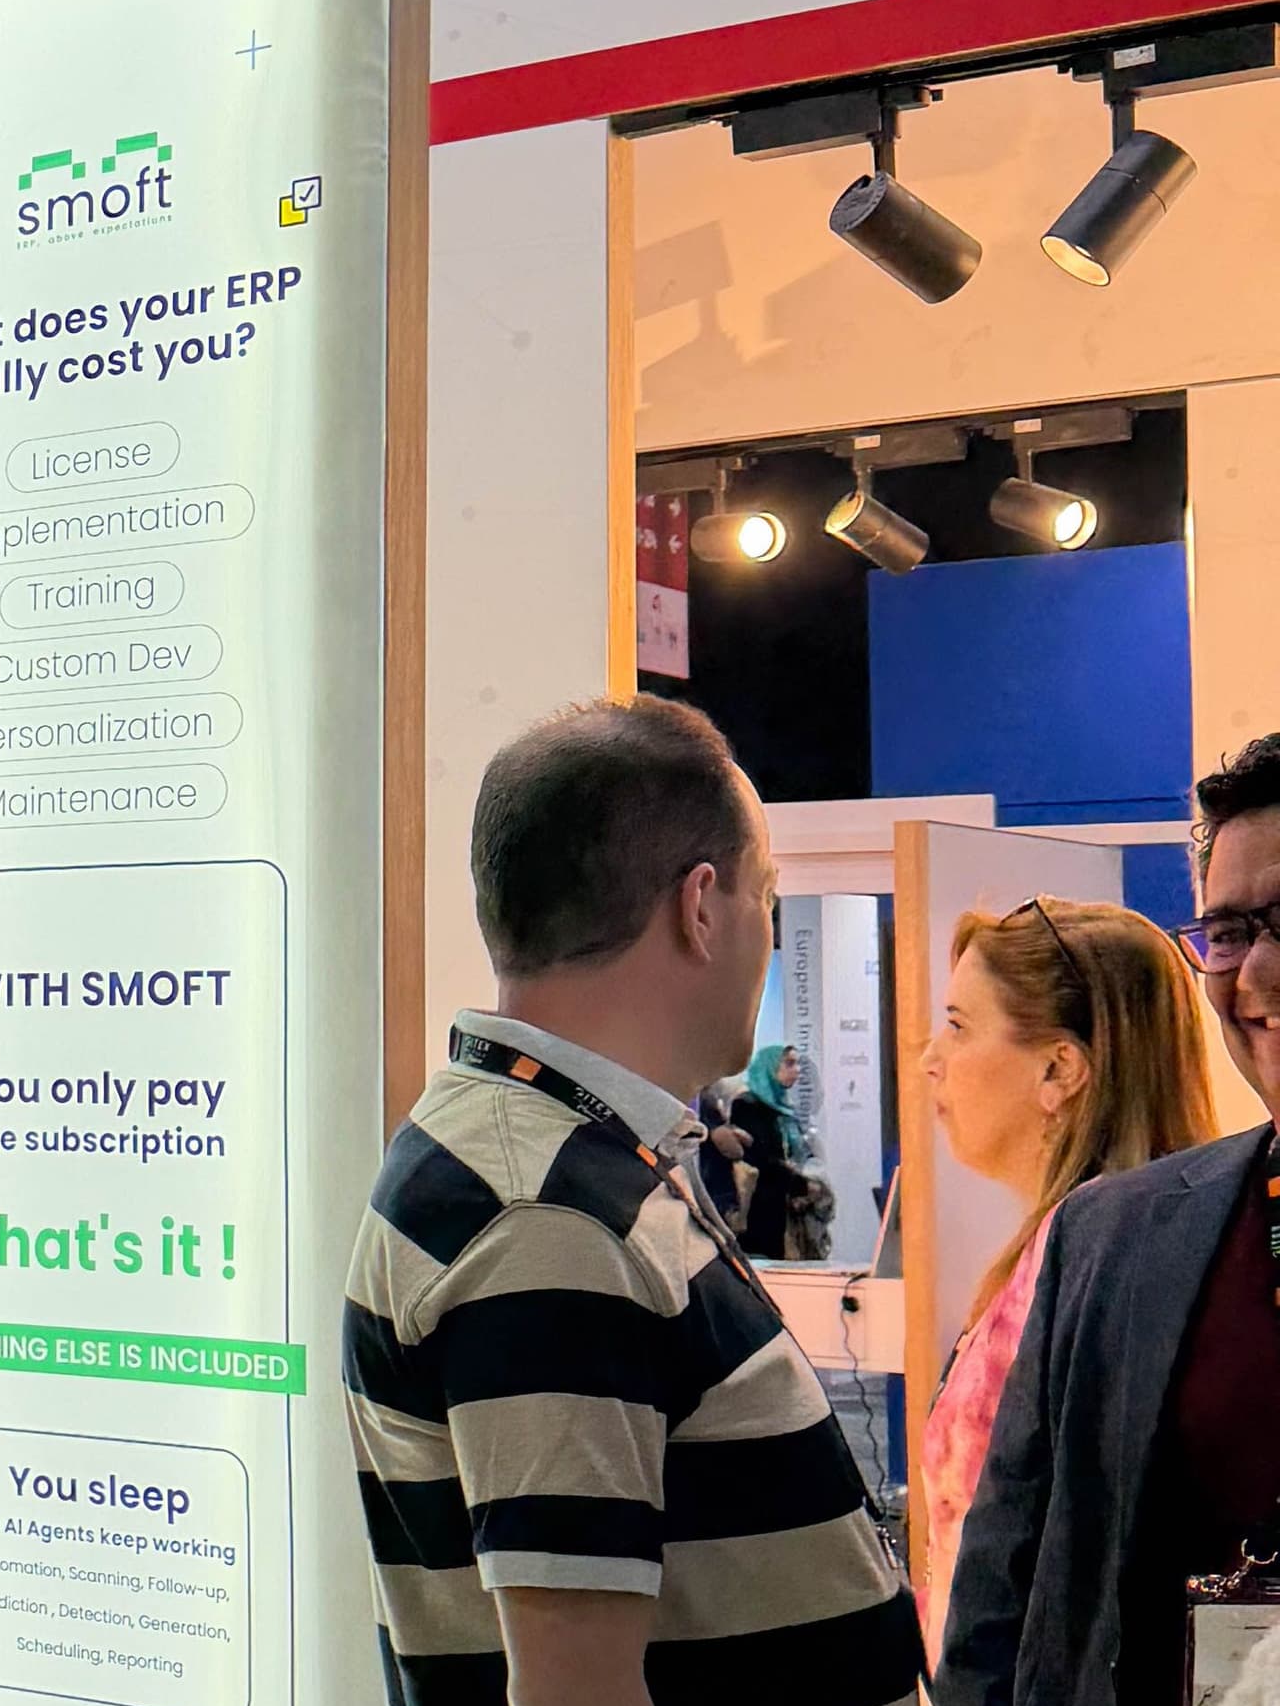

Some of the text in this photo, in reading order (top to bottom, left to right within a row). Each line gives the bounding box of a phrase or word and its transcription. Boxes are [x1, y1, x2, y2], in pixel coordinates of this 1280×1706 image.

[18, 165, 172, 235] smoft
[47, 231, 84, 244] above
[92, 214, 173, 236] expectations
[15, 304, 108, 344] does
[120, 283, 216, 339] your
[227, 265, 302, 309] ERP
[58, 341, 144, 383] cost
[159, 322, 256, 380] you?
[31, 436, 152, 481] License
[27, 570, 156, 615] Training
[128, 641, 192, 673] Dev
[82, 970, 232, 1006] SMOFT
[50, 1070, 136, 1117] only
[146, 1078, 226, 1119] pay
[25, 1126, 225, 1164] subscription
[161, 1216, 202, 1278] it
[222, 1224, 237, 1280] !
[55, 1339, 111, 1367] ELSE
[119, 1343, 143, 1369] IS
[150, 1345, 289, 1382] INCLUDED
[8, 1465, 190, 1524] You sleep
[4, 1518, 22, 1535] AI
[27, 1522, 95, 1543] Agents
[100, 1528, 149, 1554] keep
[152, 1538, 237, 1566] working
[68, 1566, 144, 1592] Scanning,
[148, 1576, 231, 1603] Follow-up,
[59, 1604, 135, 1629] Detection,
[139, 1614, 231, 1643] Generation,
[17, 1637, 184, 1678] Scheduling, Reporting
